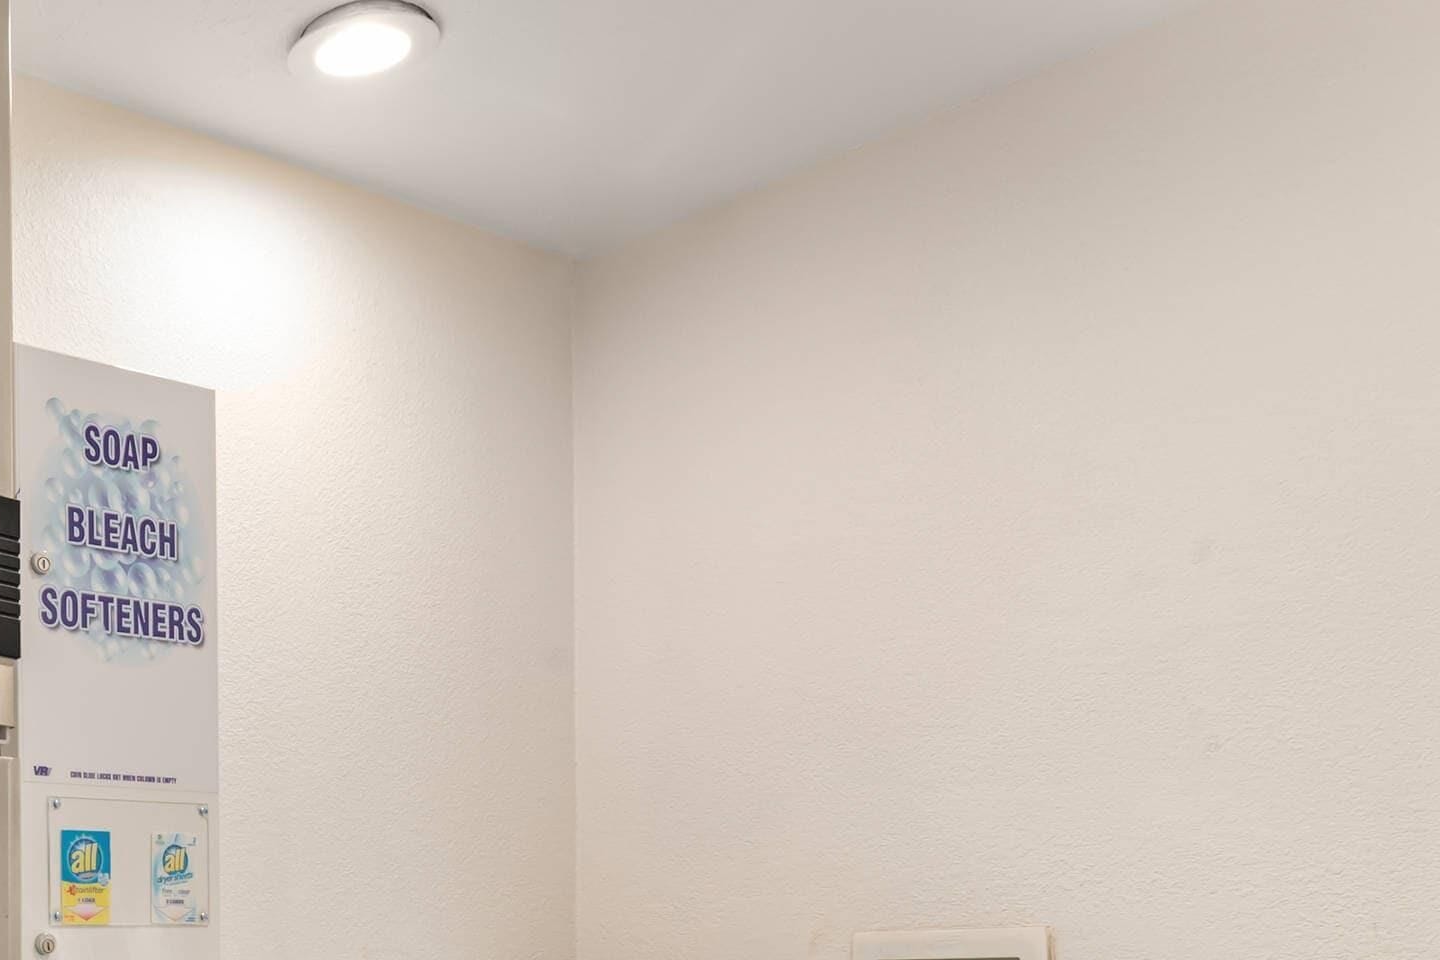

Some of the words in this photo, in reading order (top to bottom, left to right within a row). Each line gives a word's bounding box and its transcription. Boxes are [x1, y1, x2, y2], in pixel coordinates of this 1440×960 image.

[83, 425, 159, 470] SOAP
[67, 505, 177, 559] BLEACH
[40, 587, 203, 644] SOFTENERS
[71, 842, 98, 873] all
[165, 847, 186, 873] all
